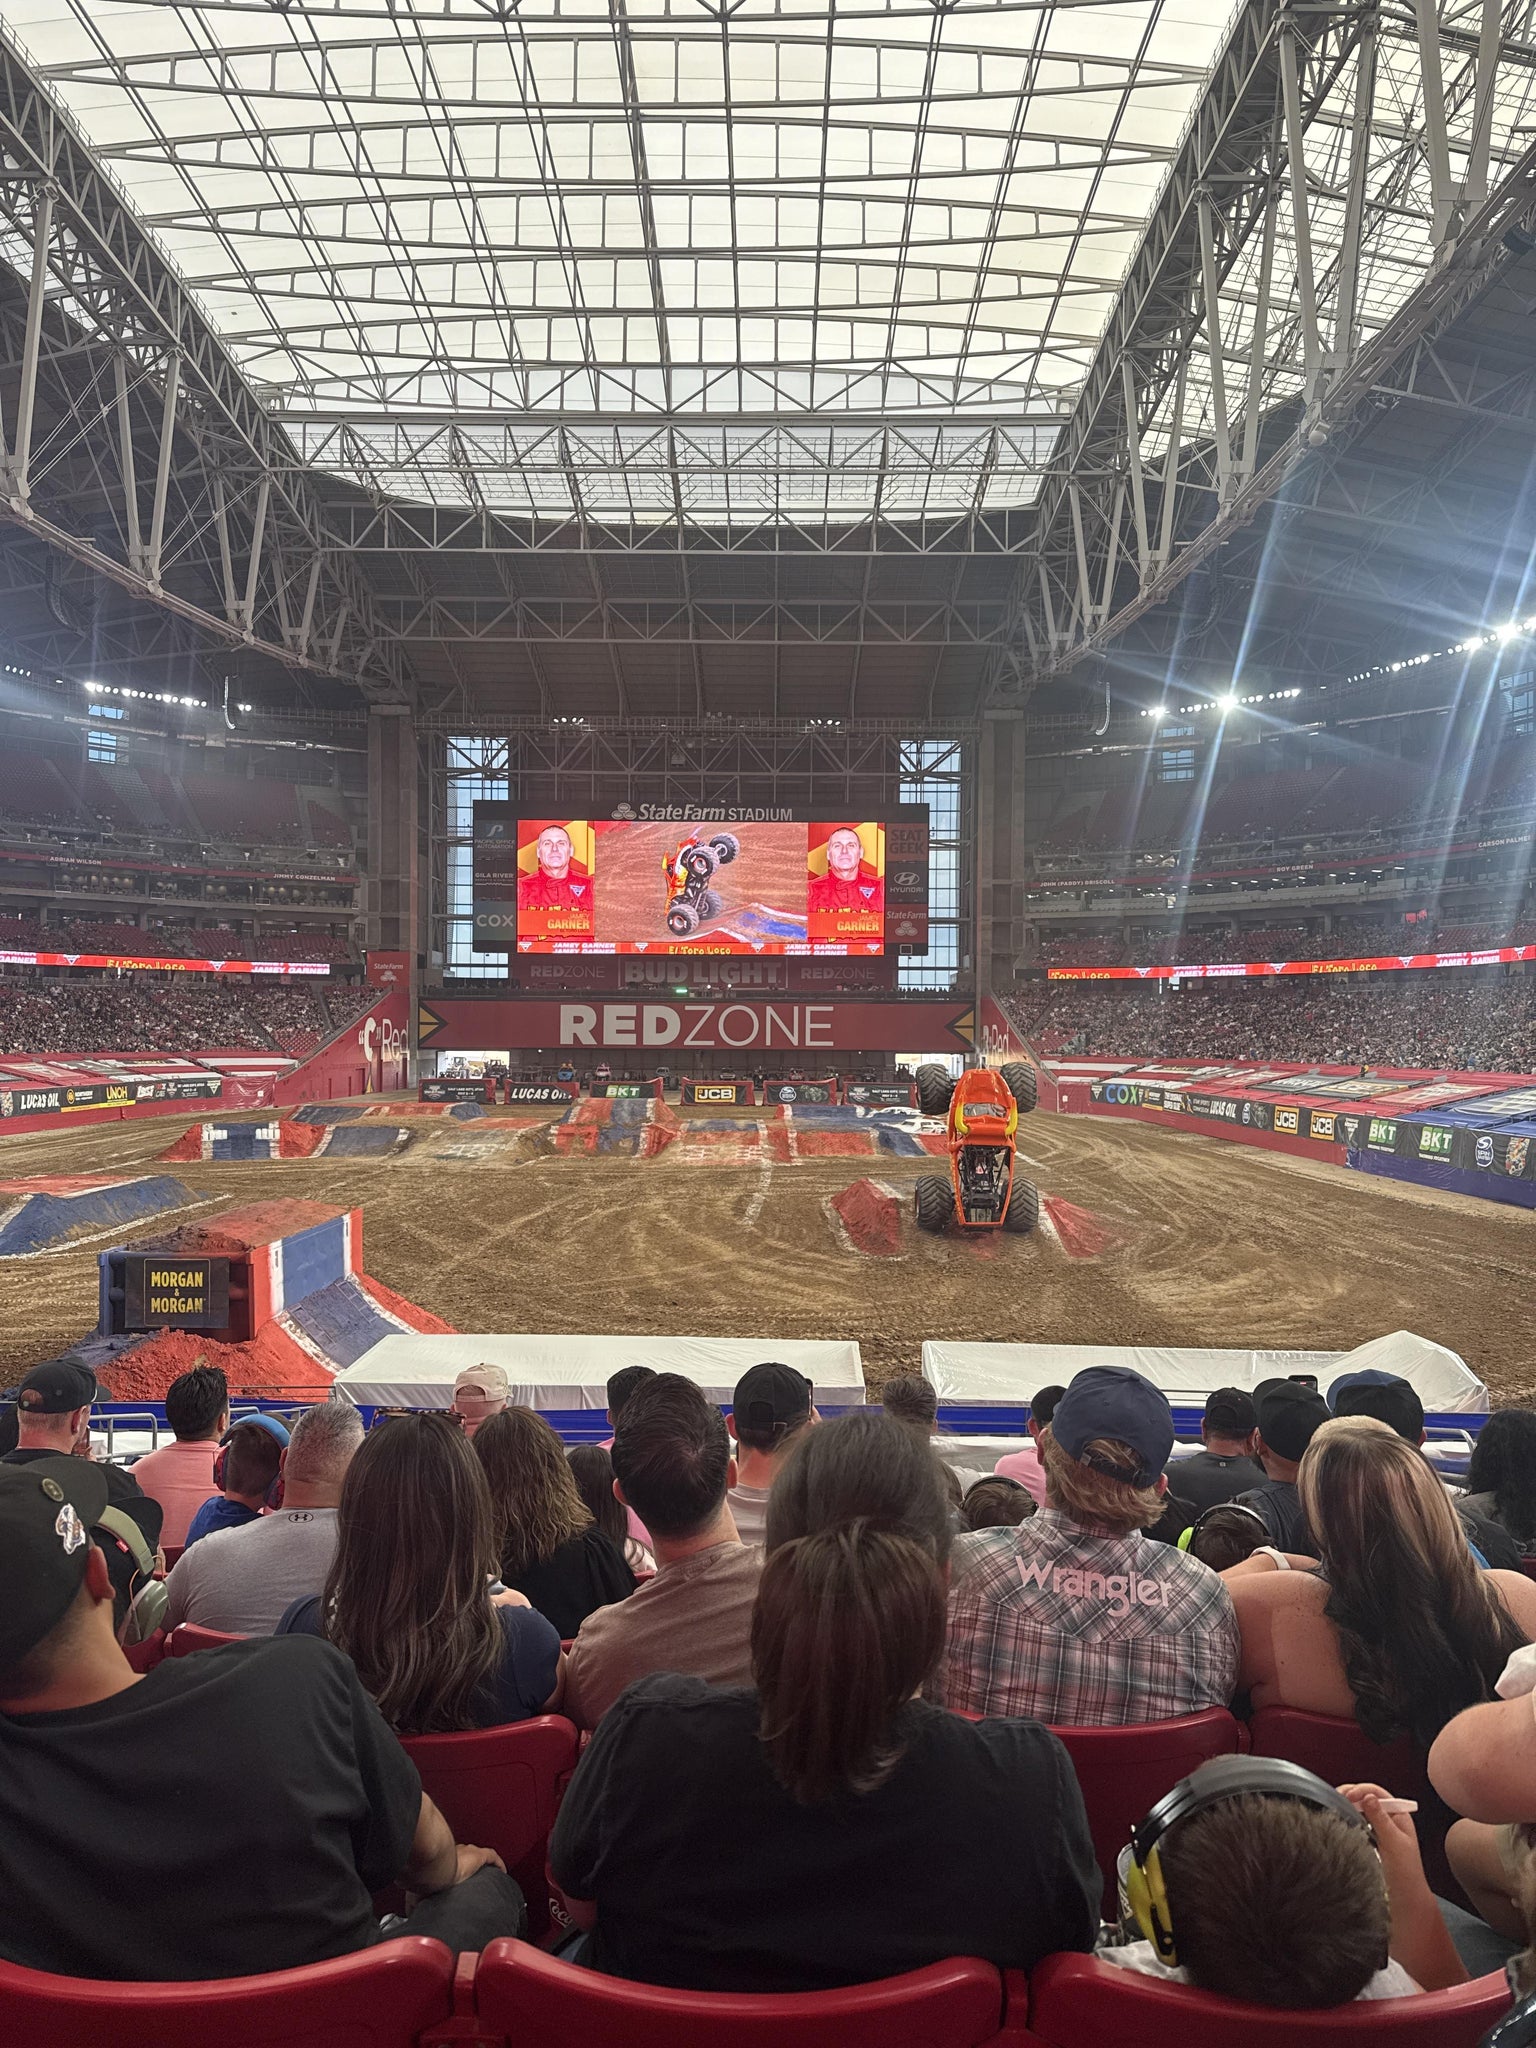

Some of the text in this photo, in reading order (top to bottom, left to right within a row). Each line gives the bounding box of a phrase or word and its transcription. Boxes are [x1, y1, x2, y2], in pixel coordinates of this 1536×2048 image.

[728, 808, 793, 821] STADIUM
[891, 829, 922, 841] SEAT
[889, 842, 924, 855] GEEK
[1478, 839, 1505, 848] CARSON
[476, 914, 514, 928] COX
[547, 919, 590, 930] GARNER
[837, 920, 880, 932] GARNER
[707, 946, 731, 955] Loco
[1436, 957, 1469, 967] JAMEY
[1470, 954, 1500, 965] GARNER
[287, 966, 330, 975] GARNER
[624, 961, 781, 984] BUD LIGHT
[1172, 969, 1204, 977] JAMEY
[1206, 968, 1247, 976] GARNER
[382, 1018, 410, 1062] Red
[106, 1085, 128, 1100] UNOH
[511, 1088, 550, 1100] LUCAS
[606, 1085, 640, 1098] BKT
[698, 1088, 733, 1100] JCB
[1105, 1084, 1138, 1105] COX
[20, 1093, 60, 1109] LUCAS OIL
[1209, 1100, 1225, 1116] LUCAS
[1225, 1102, 1237, 1118] OIL
[1276, 1110, 1297, 1129] JCB
[1312, 1116, 1333, 1135] JCB
[1368, 1122, 1397, 1142] BKT
[1420, 1131, 1453, 1150] BKT
[151, 1271, 204, 1287] MORGAN
[174, 1288, 180, 1297] &
[151, 1297, 204, 1313] MORGAN
[1014, 1555, 1173, 1617] Wrangler
